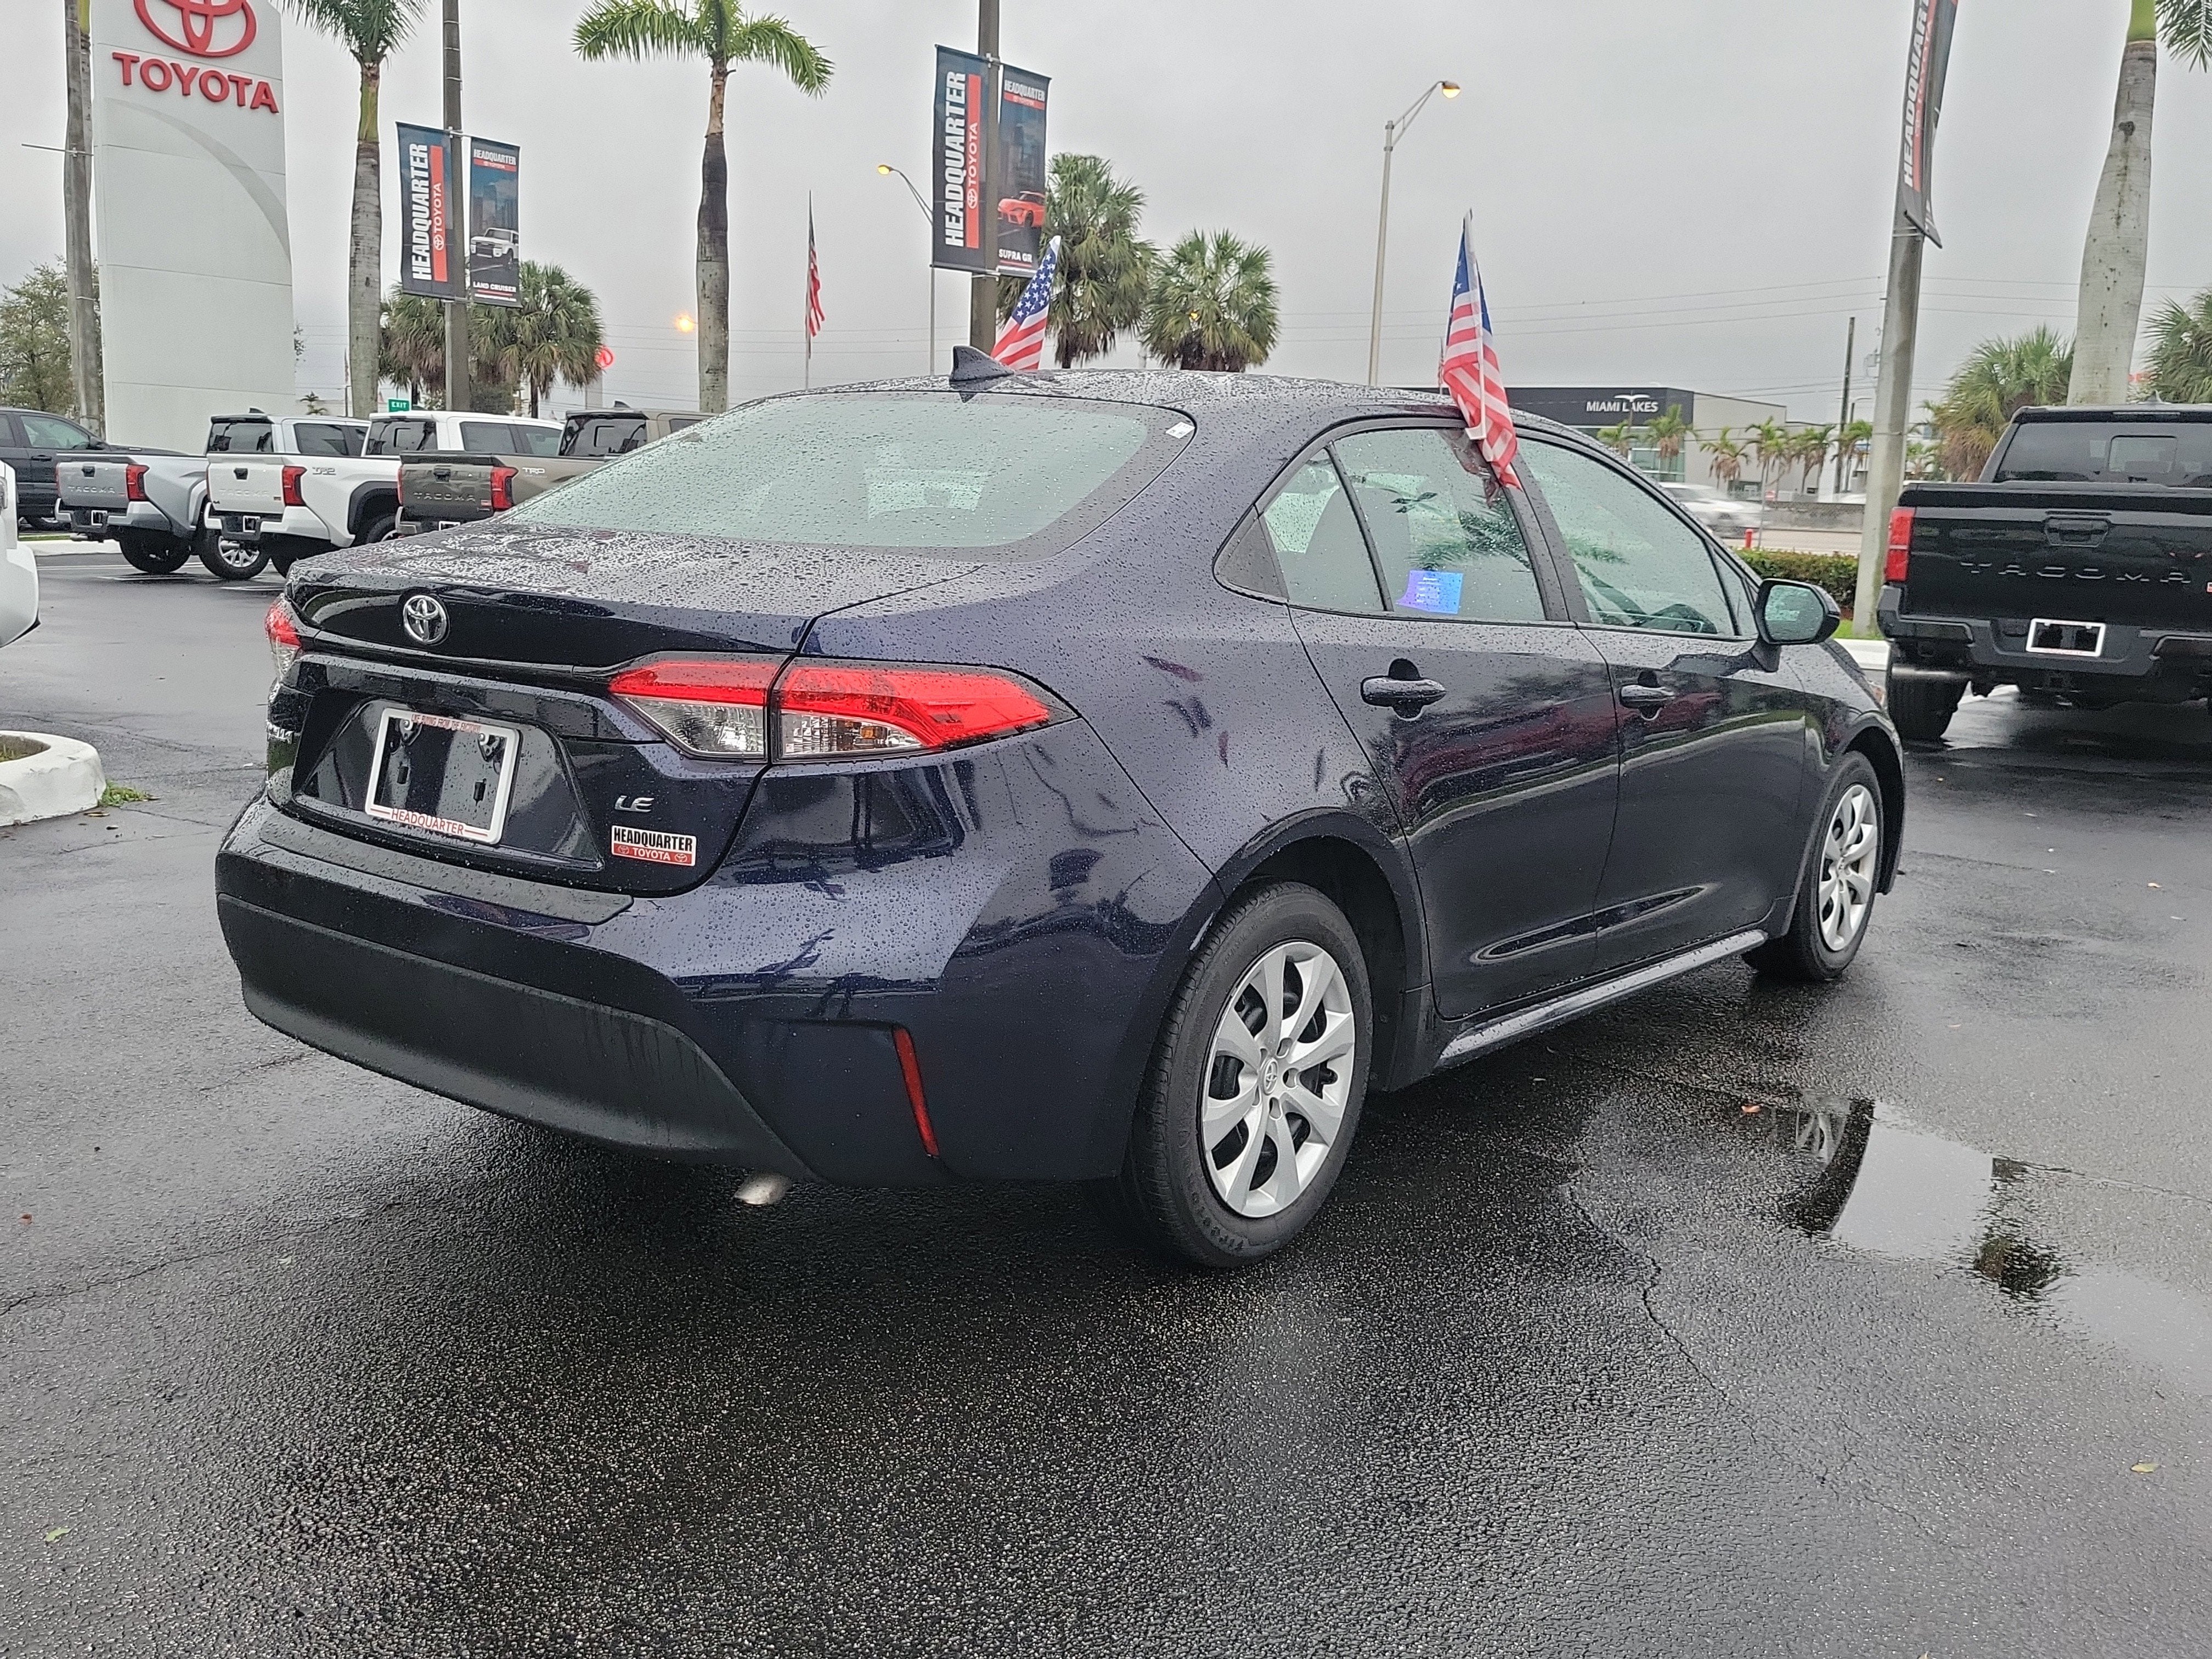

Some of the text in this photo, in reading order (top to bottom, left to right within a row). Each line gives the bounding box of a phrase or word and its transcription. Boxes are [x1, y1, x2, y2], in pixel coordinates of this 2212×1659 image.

[112, 52, 279, 114] TOYOTA
[1004, 80, 1045, 102] HEADQUARTER
[473, 149, 516, 166] HEADQUARTER
[945, 71, 967, 247] HEADQUARTER
[968, 122, 978, 187] TOYOTA
[409, 143, 432, 280] HEADQUARTER
[433, 183, 443, 233] TOYOTA
[998, 249, 1032, 263] SUPRA GR
[473, 281, 517, 293] LAND CRUISER
[1586, 401, 1658, 413] MIAMI LAKES
[67, 485, 115, 494] TACOMA
[413, 492, 476, 503] TACOMA
[1960, 562, 2191, 584] TACOMA
[614, 795, 654, 813] LE
[391, 809, 465, 835] HEADQUARTER
[613, 827, 693, 852] HEADQUARTER
[631, 847, 672, 861] TOYOTA
